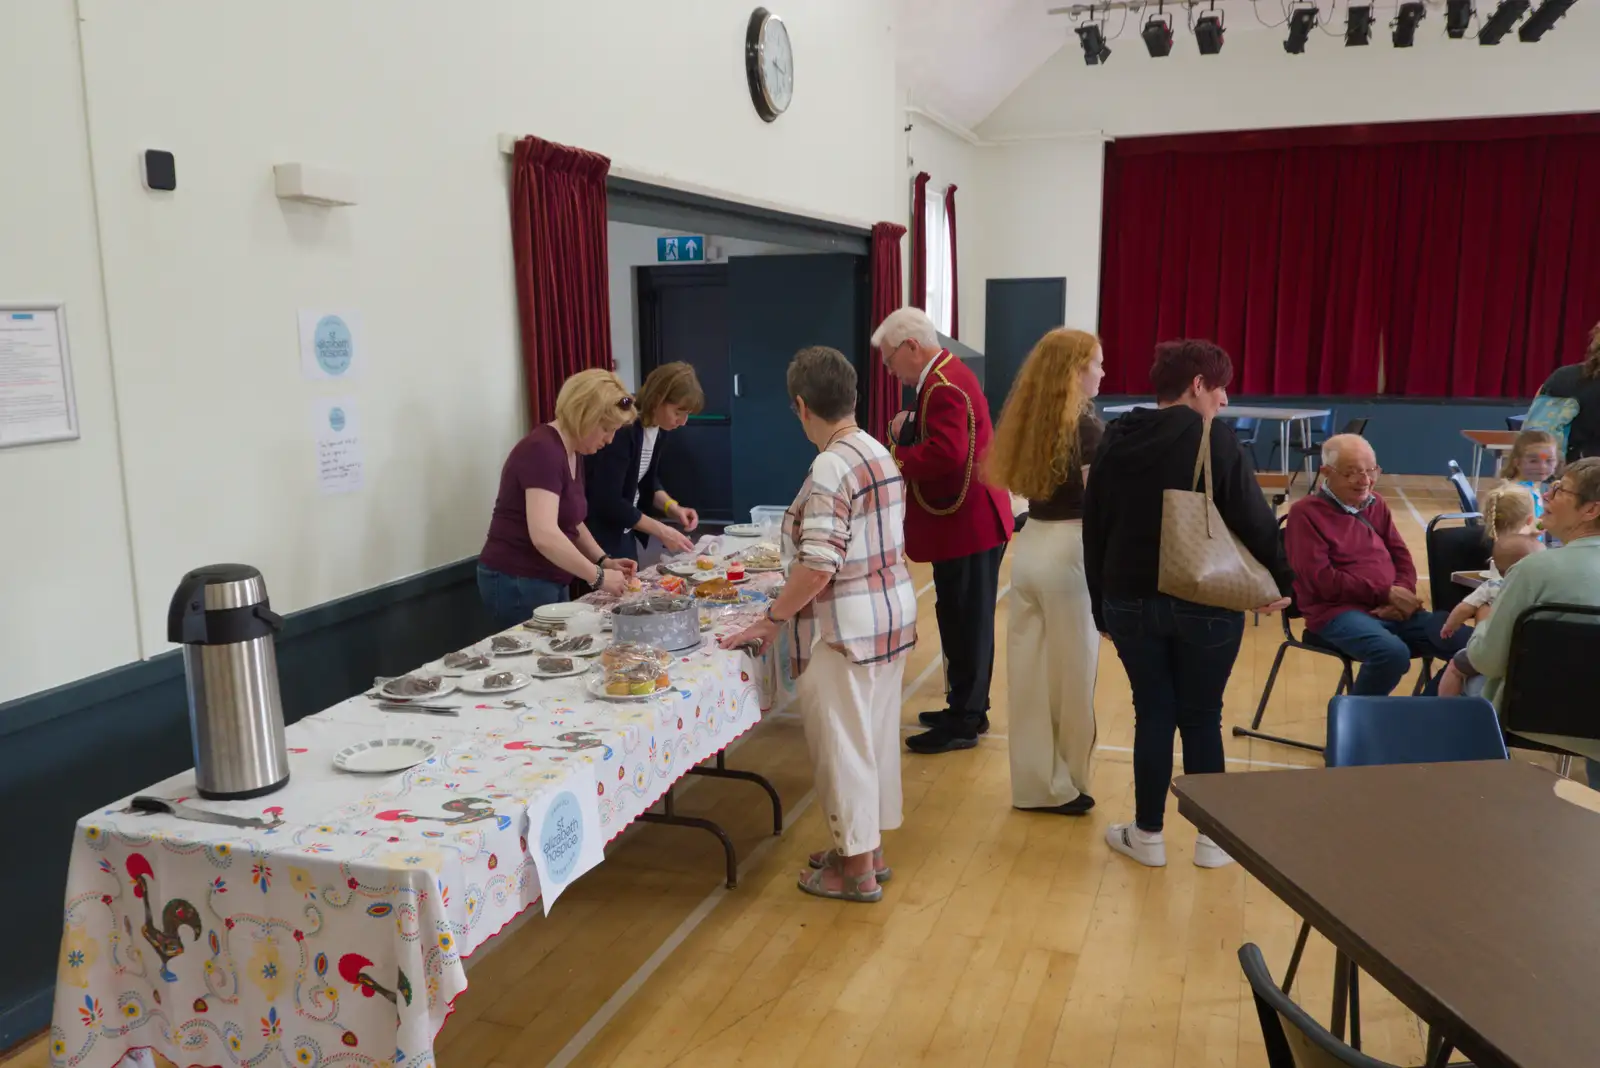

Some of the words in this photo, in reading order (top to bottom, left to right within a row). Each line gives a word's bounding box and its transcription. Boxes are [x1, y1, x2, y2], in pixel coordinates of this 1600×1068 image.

[543, 818, 579, 854] elizabeth
[556, 816, 564, 831] st
[546, 834, 579, 864] hospice
